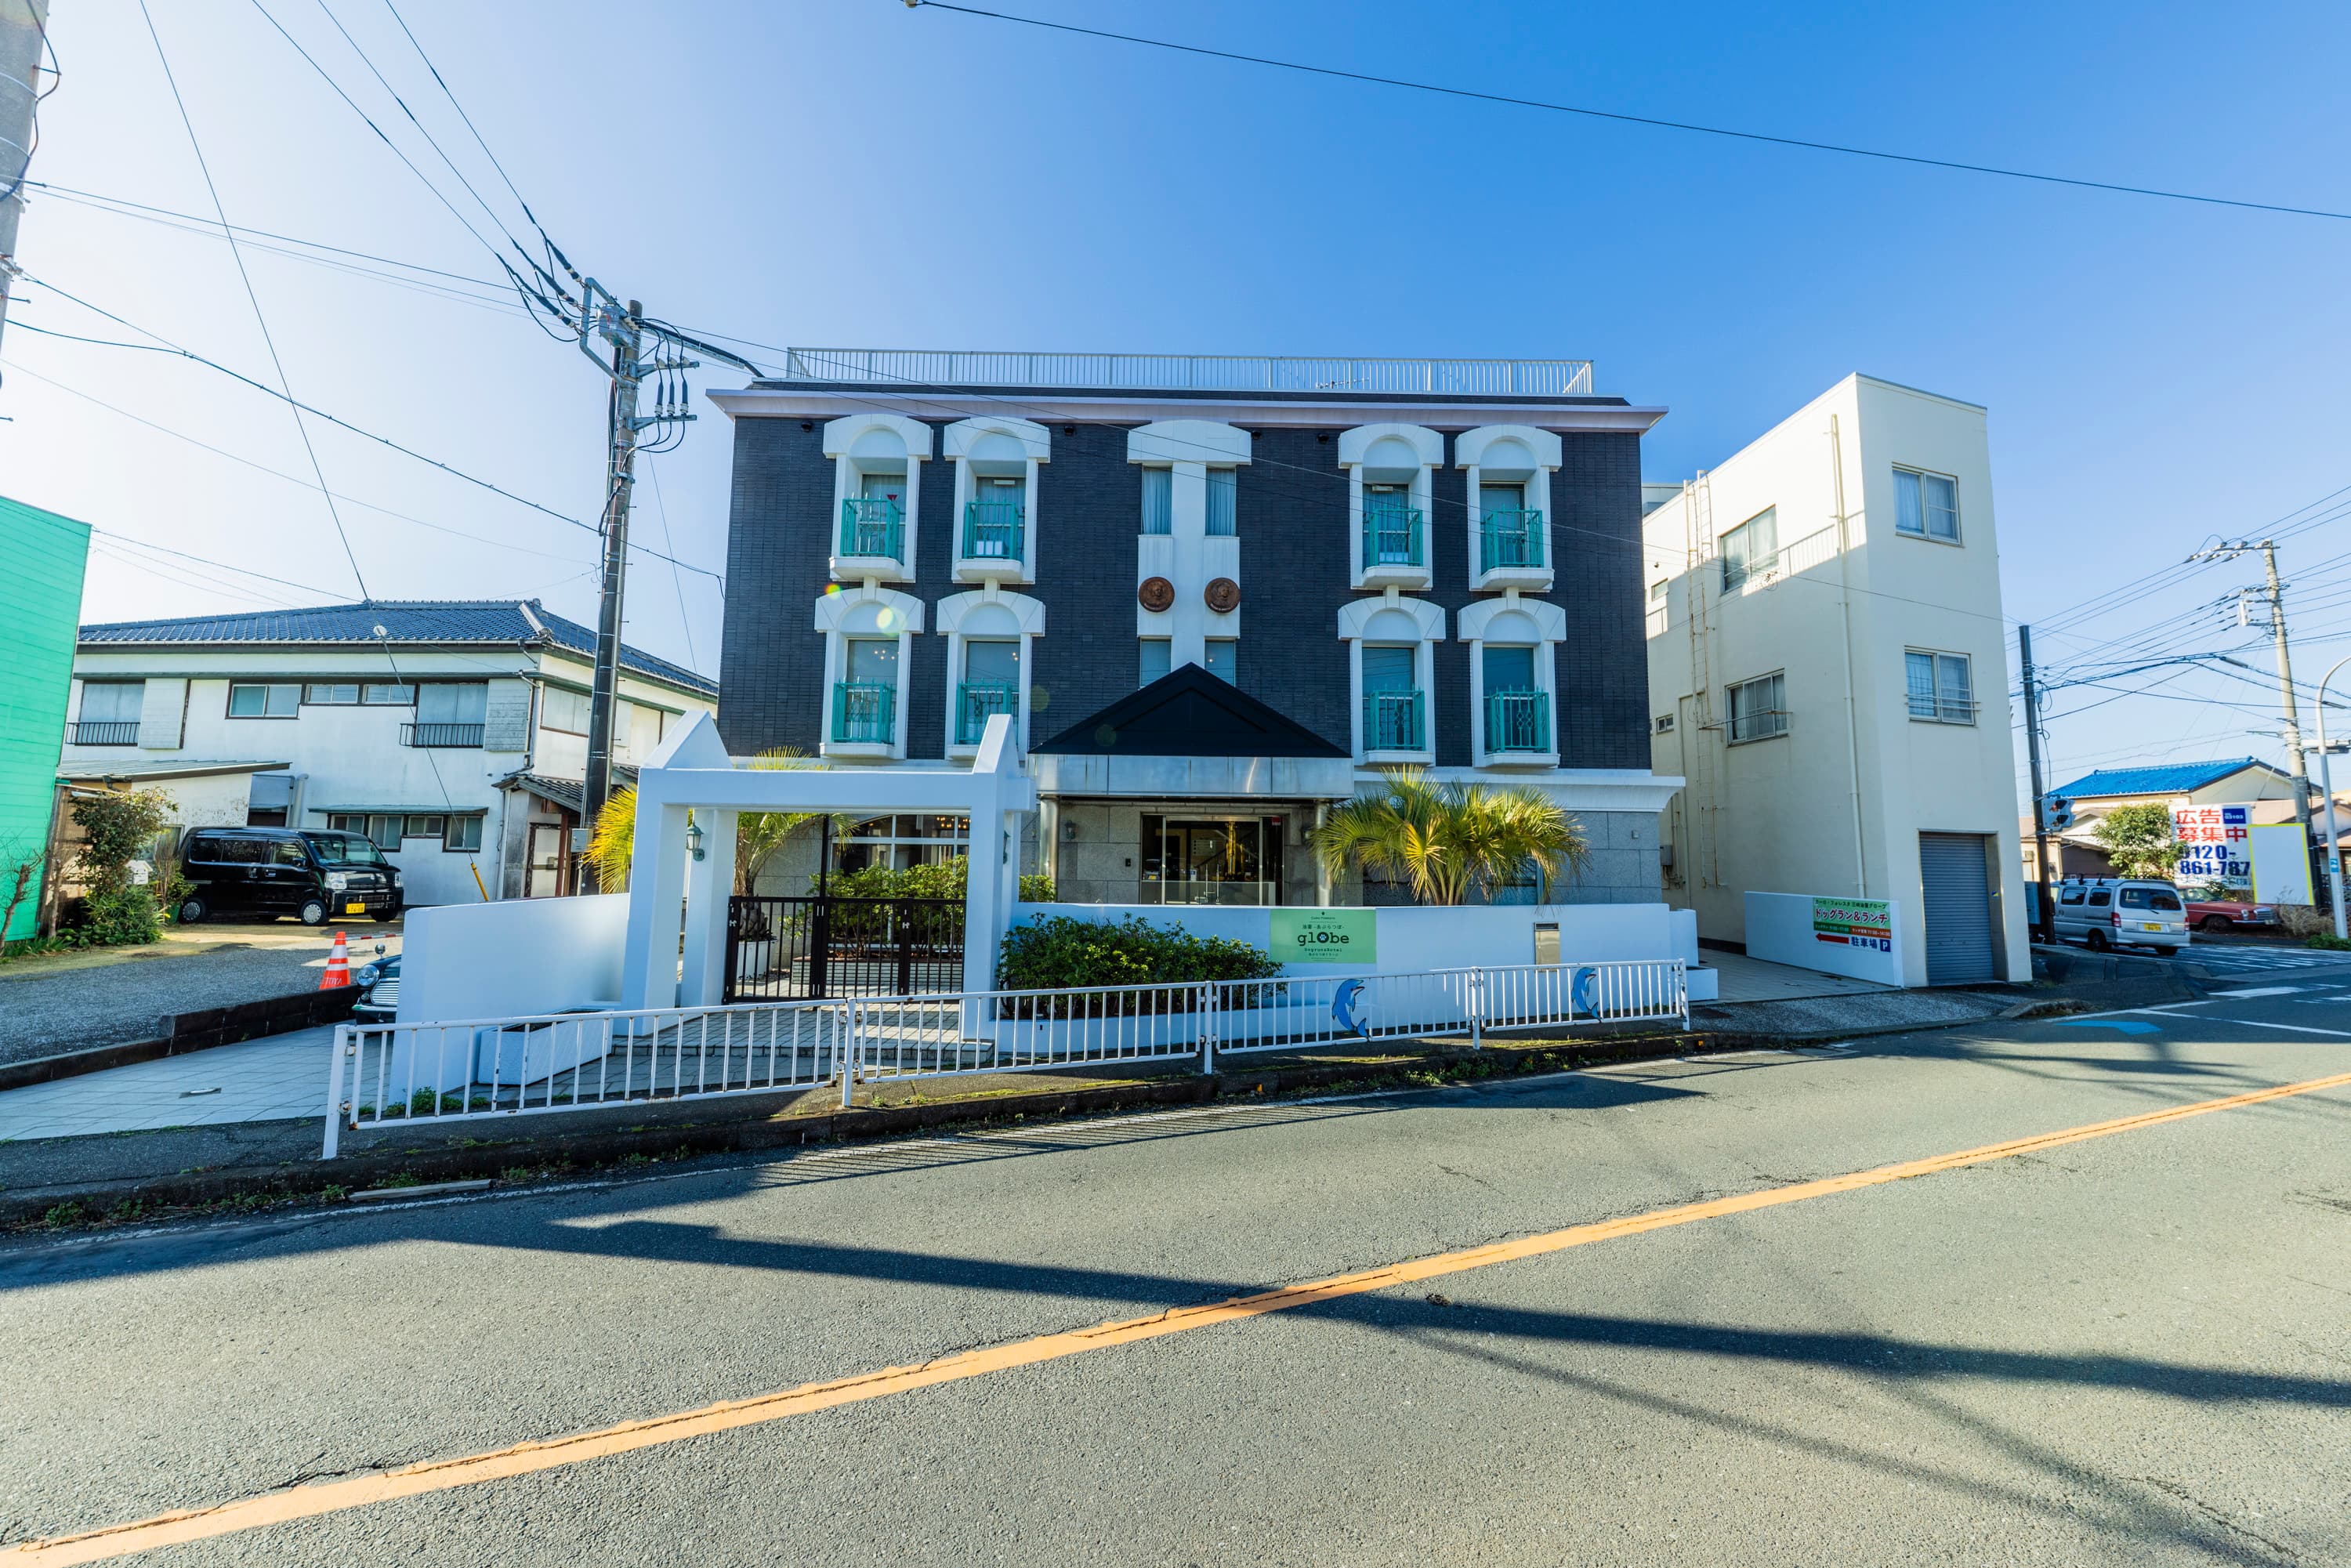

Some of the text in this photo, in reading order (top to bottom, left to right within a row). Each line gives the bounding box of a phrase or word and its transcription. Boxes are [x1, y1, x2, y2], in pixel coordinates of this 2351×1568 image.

[2176, 809, 2221, 824] 広告
[2176, 826, 2248, 842] 募集中
[2179, 860, 2251, 876] 861-787
[1851, 936, 1888, 950] 駐車場 P
